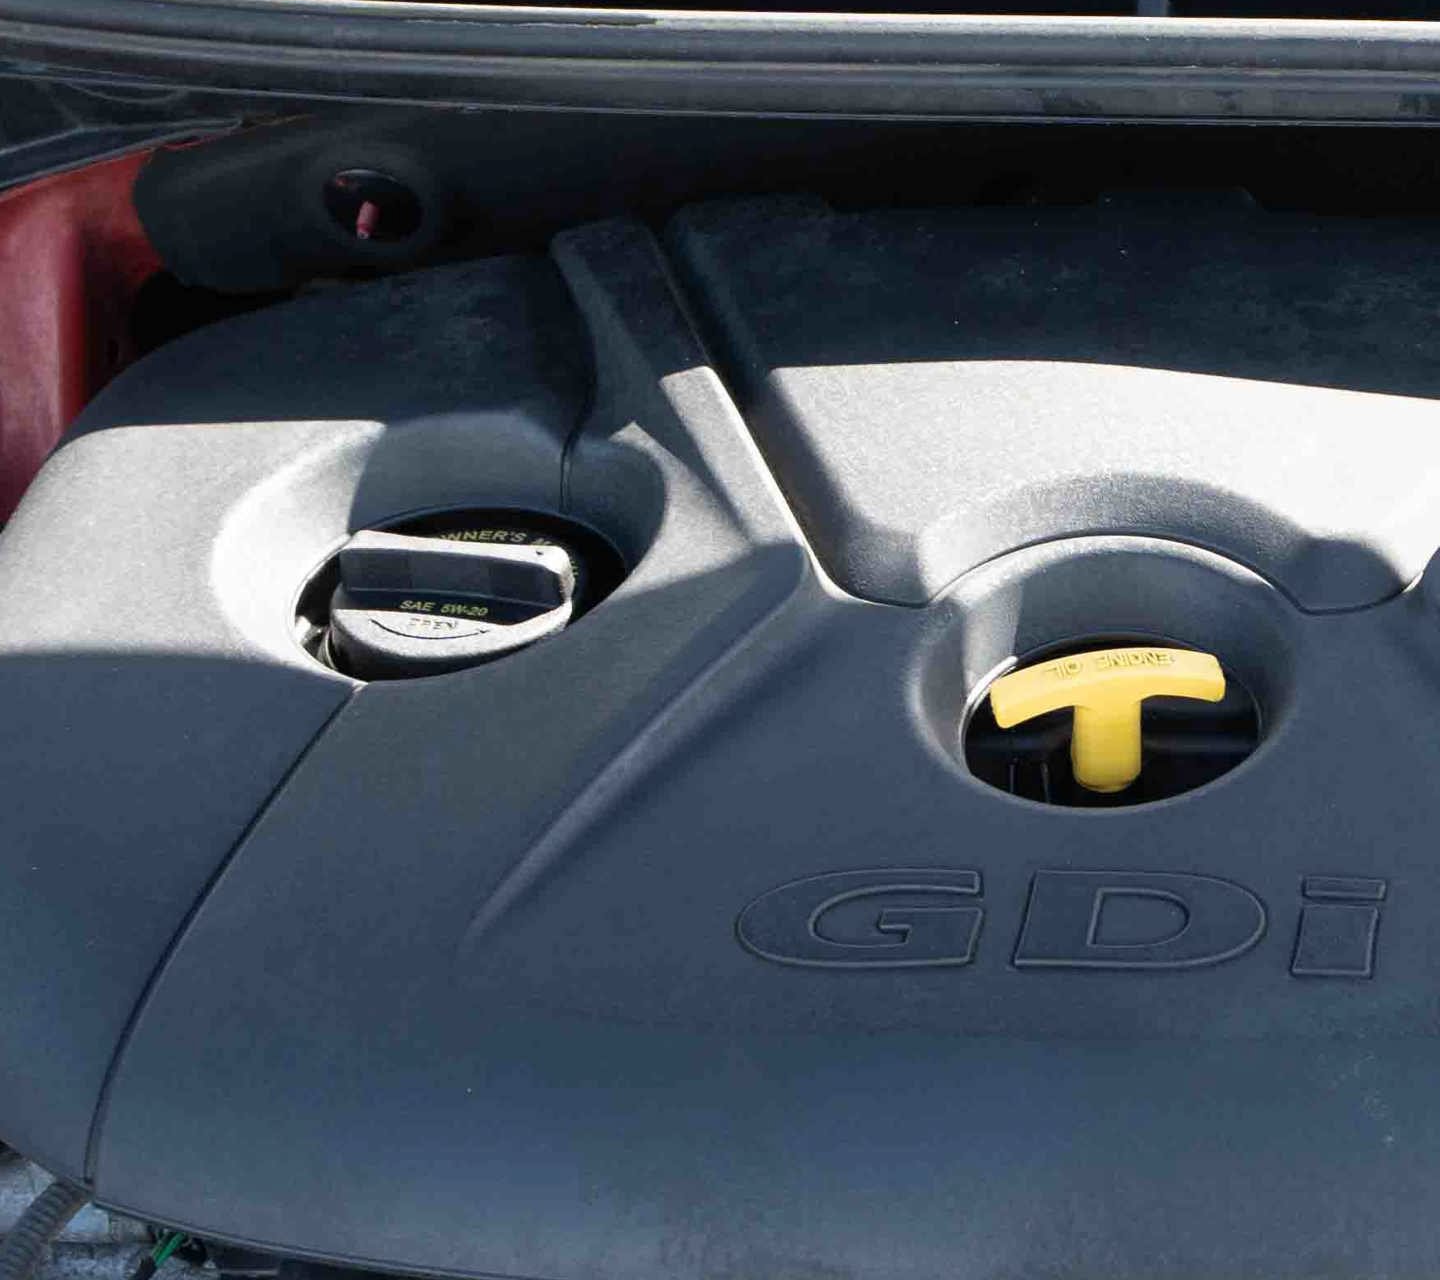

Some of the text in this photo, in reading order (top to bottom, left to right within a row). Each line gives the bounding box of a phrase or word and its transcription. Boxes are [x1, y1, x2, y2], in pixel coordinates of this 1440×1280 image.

[440, 530, 527, 543] WNER'S
[399, 600, 489, 617] SAE 5W-20
[1044, 651, 1174, 679] ENGINE OIL
[735, 868, 1387, 978] GDi
